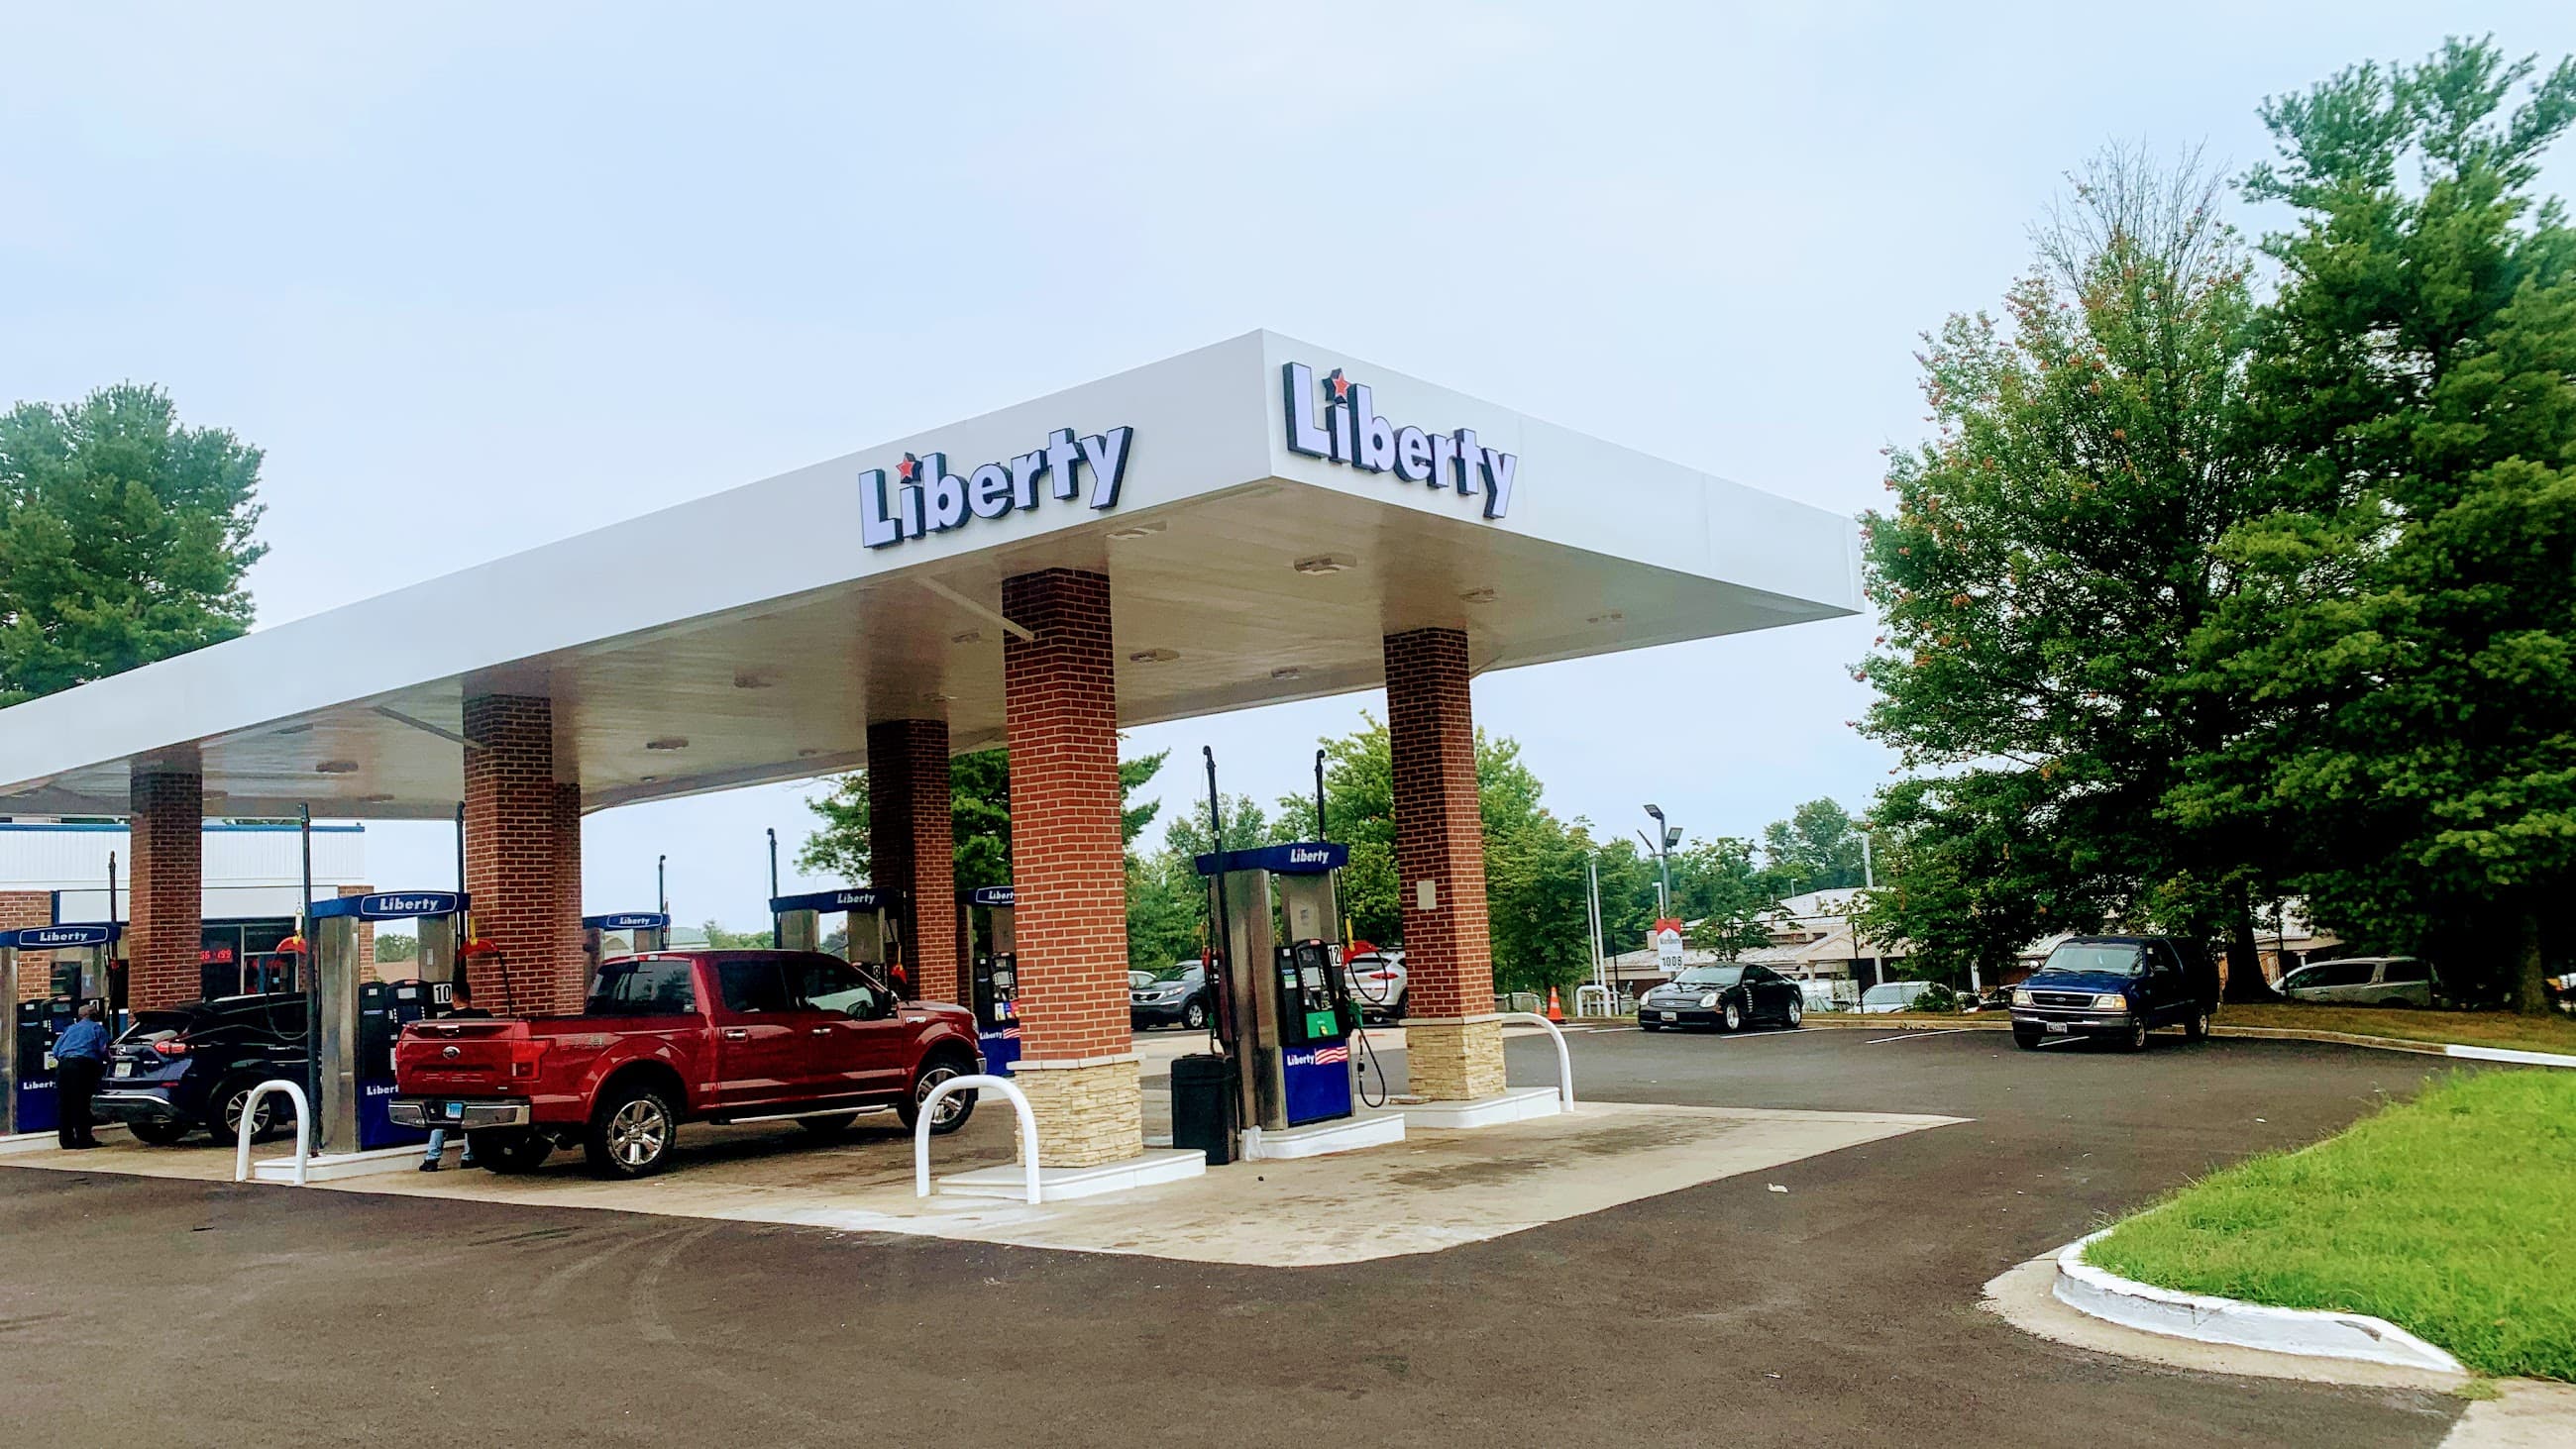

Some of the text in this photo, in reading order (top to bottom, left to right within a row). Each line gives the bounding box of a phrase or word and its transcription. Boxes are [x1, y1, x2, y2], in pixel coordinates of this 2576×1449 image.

[1282, 362, 1518, 520] Liberty
[858, 426, 1133, 550] Liberty
[1290, 848, 1330, 865] Liberty
[836, 892, 876, 905] Liberty
[988, 890, 1015, 900] Libert
[378, 897, 439, 911] Liberty
[619, 917, 650, 926] Liberty
[40, 931, 88, 942] Liberty
[1329, 946, 1342, 966] 12
[436, 984, 451, 1002] 10
[1287, 1054, 1315, 1067] Liberty
[367, 1084, 399, 1095] Libert
